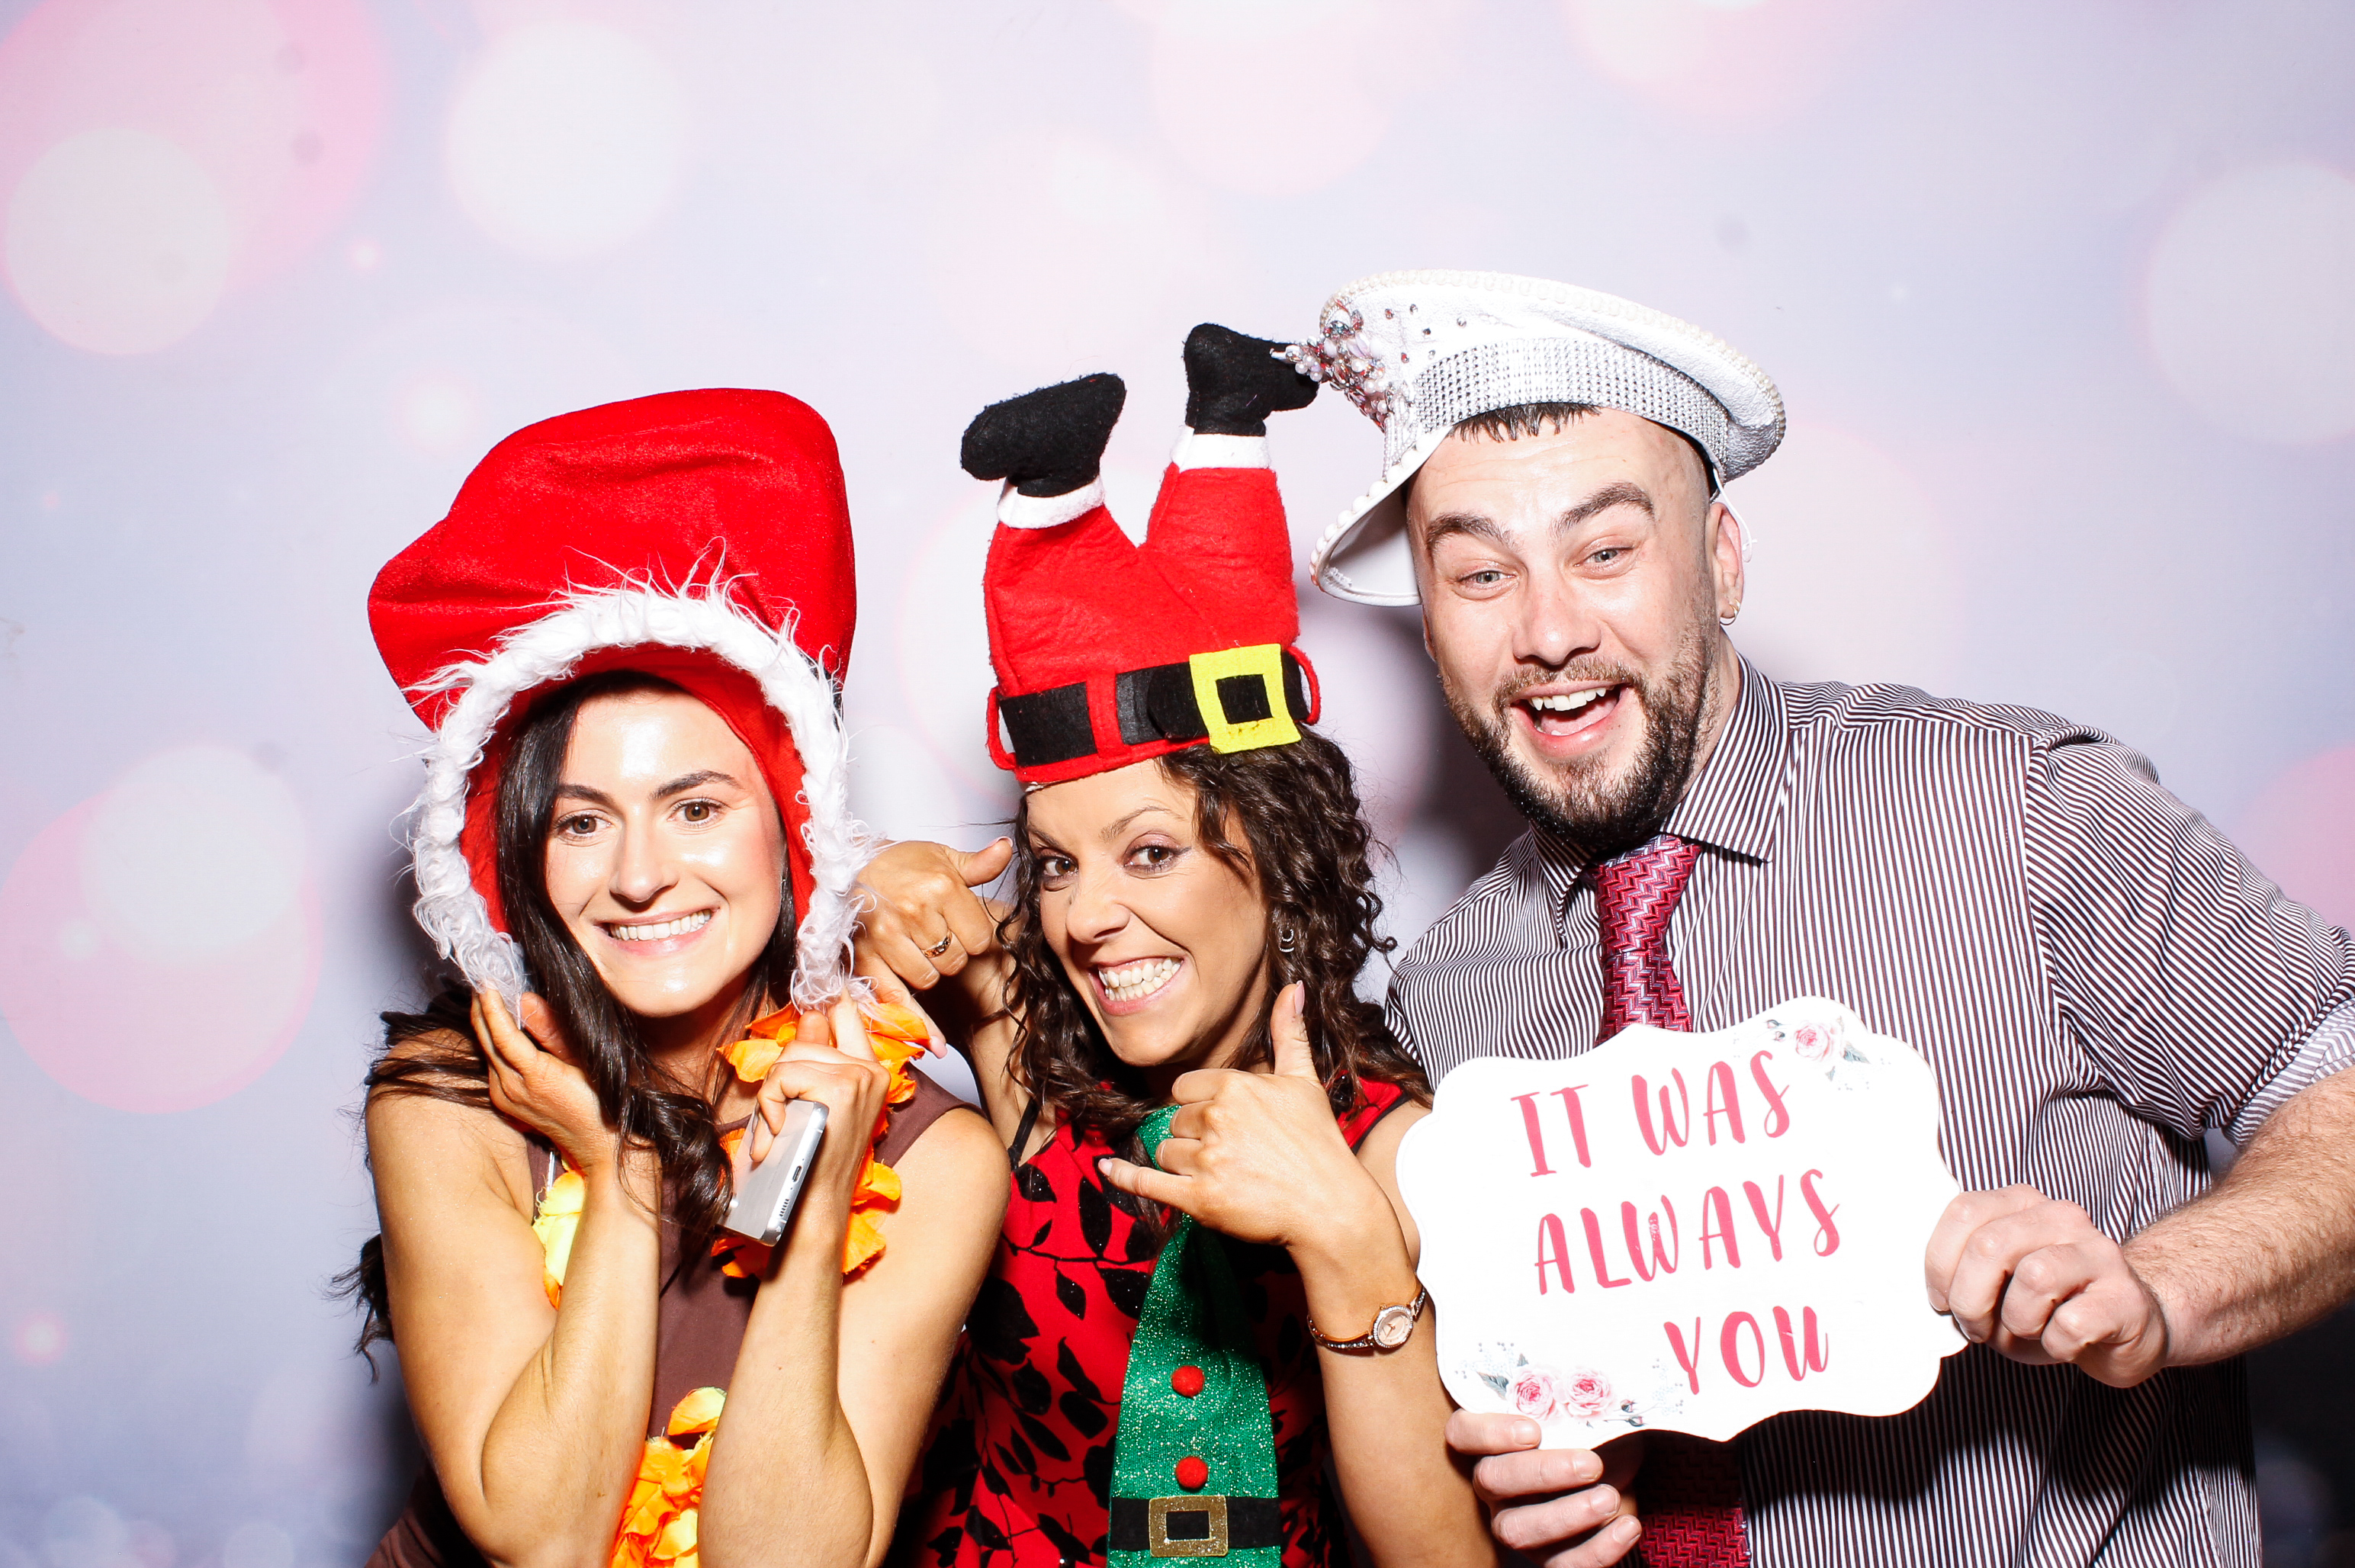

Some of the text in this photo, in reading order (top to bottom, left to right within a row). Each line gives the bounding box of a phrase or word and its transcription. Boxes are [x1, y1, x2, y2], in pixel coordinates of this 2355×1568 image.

[1510, 1050, 1791, 1177] IT WAS
[1534, 1168, 1841, 1295] ALWAYS
[1663, 1306, 1829, 1395] YOU
